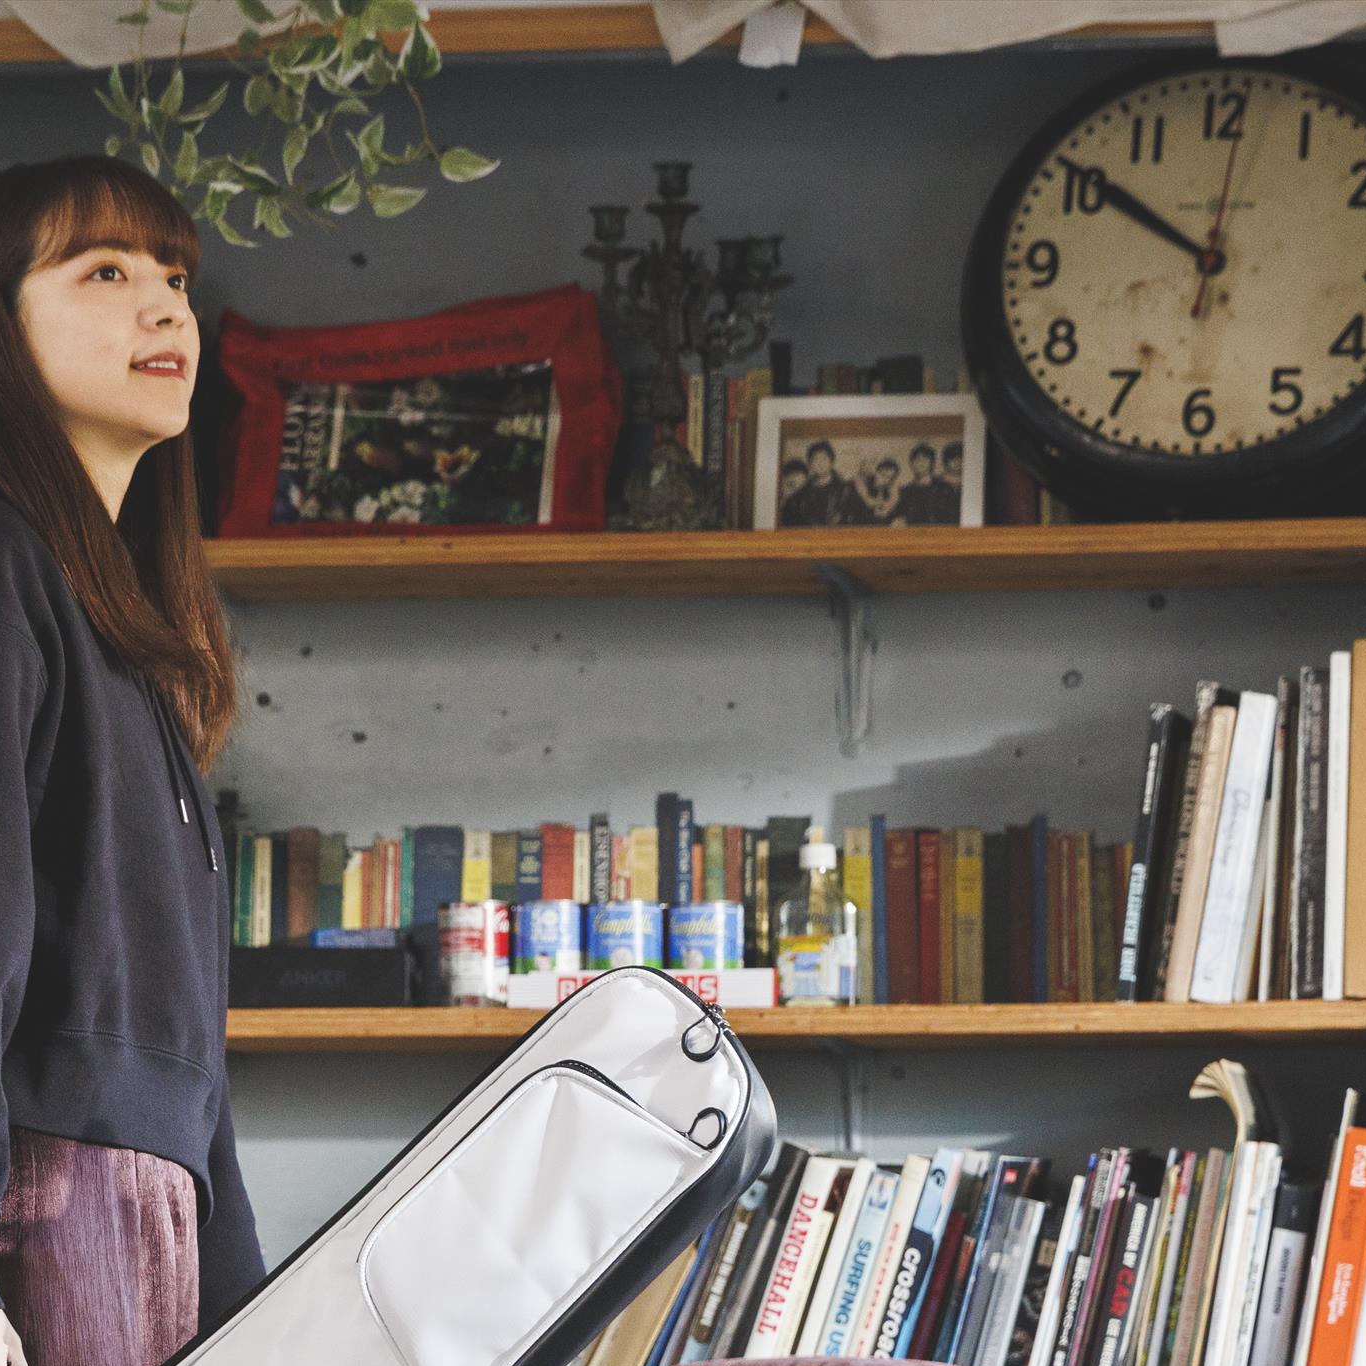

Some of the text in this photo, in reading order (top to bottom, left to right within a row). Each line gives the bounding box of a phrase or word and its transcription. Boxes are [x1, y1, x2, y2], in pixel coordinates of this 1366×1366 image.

[1131, 115, 1164, 165] 11
[1203, 92, 1245, 142] 12
[1298, 111, 1312, 161] 1
[1063, 166, 1106, 216] 10
[1026, 240, 1060, 289] 9
[1043, 318, 1078, 365] 8
[1329, 314, 1366, 363] 4
[1109, 369, 1142, 418] 7
[1182, 388, 1217, 438] 6
[1269, 367, 1304, 416] 5
[756, 1191, 819, 1336] DANCEHALL
[832, 1238, 874, 1327] SURFING
[1110, 1267, 1134, 1318] CAR
